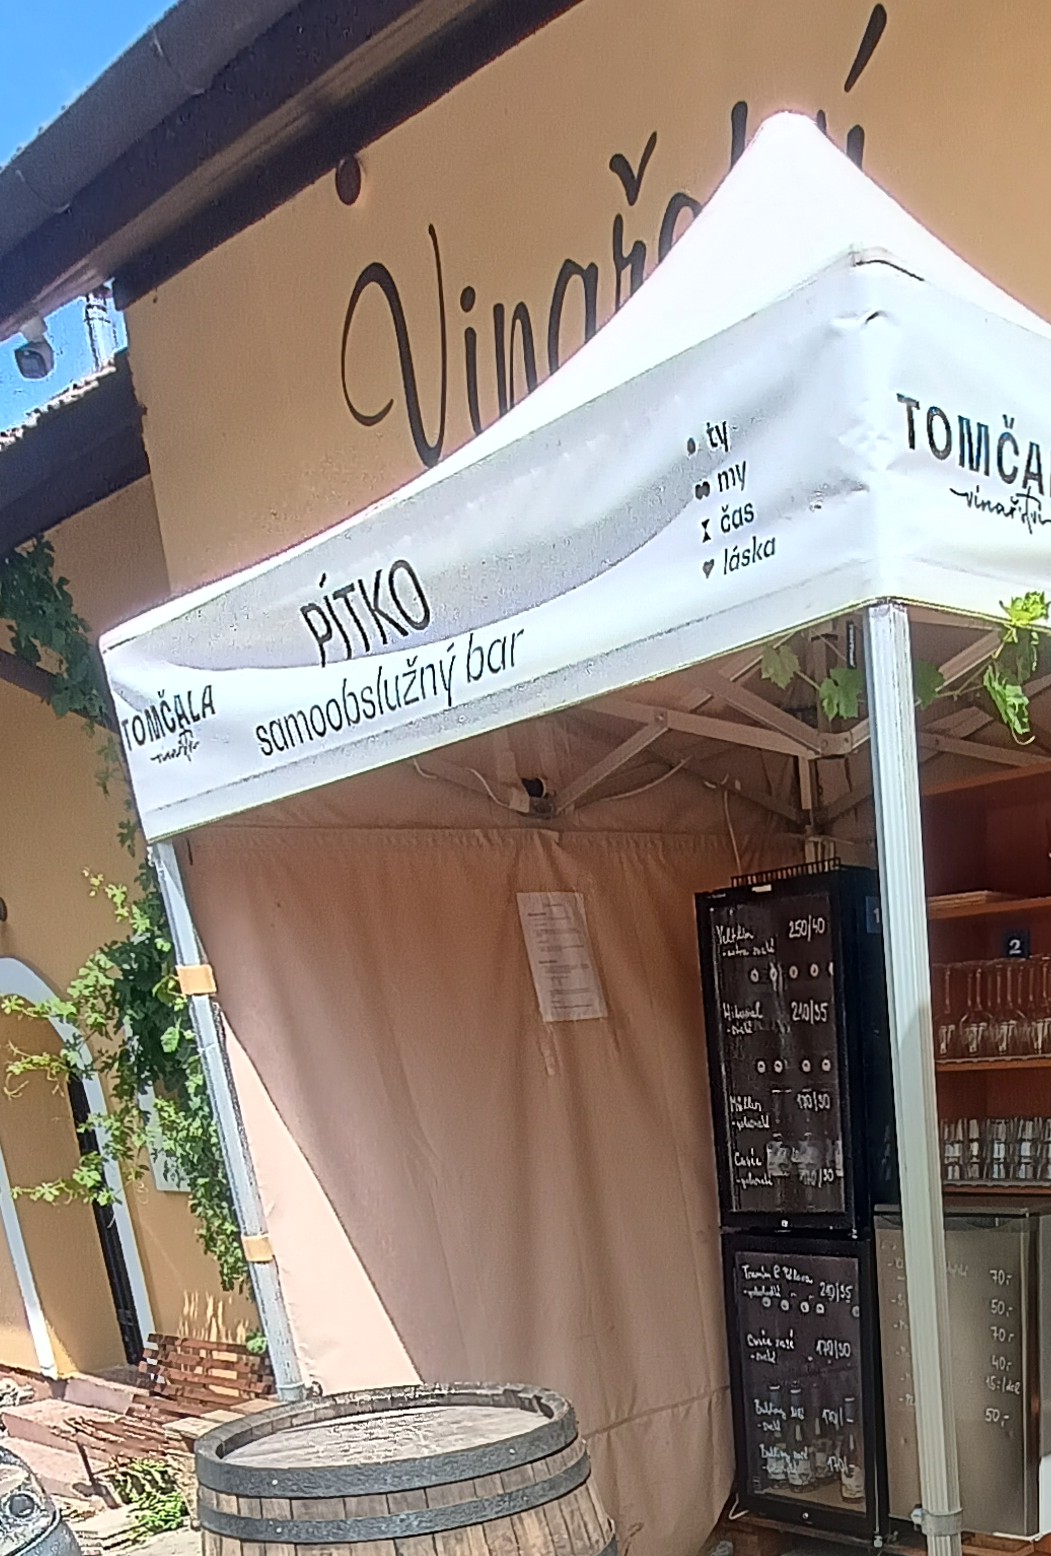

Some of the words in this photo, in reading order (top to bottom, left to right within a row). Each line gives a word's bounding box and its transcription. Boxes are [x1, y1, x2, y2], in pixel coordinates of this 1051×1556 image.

[706, 420, 728, 453] ty
[717, 460, 747, 493] my
[721, 502, 756, 535] čas
[724, 535, 777, 576] láska
[299, 559, 431, 668] PÍTKO
[255, 641, 457, 756] samoobslužný
[466, 629, 525, 683] bar
[121, 684, 217, 751] TOMČALA
[788, 914, 826, 942] 250/40
[873, 906, 881, 924] 1
[1009, 938, 1022, 955] 2
